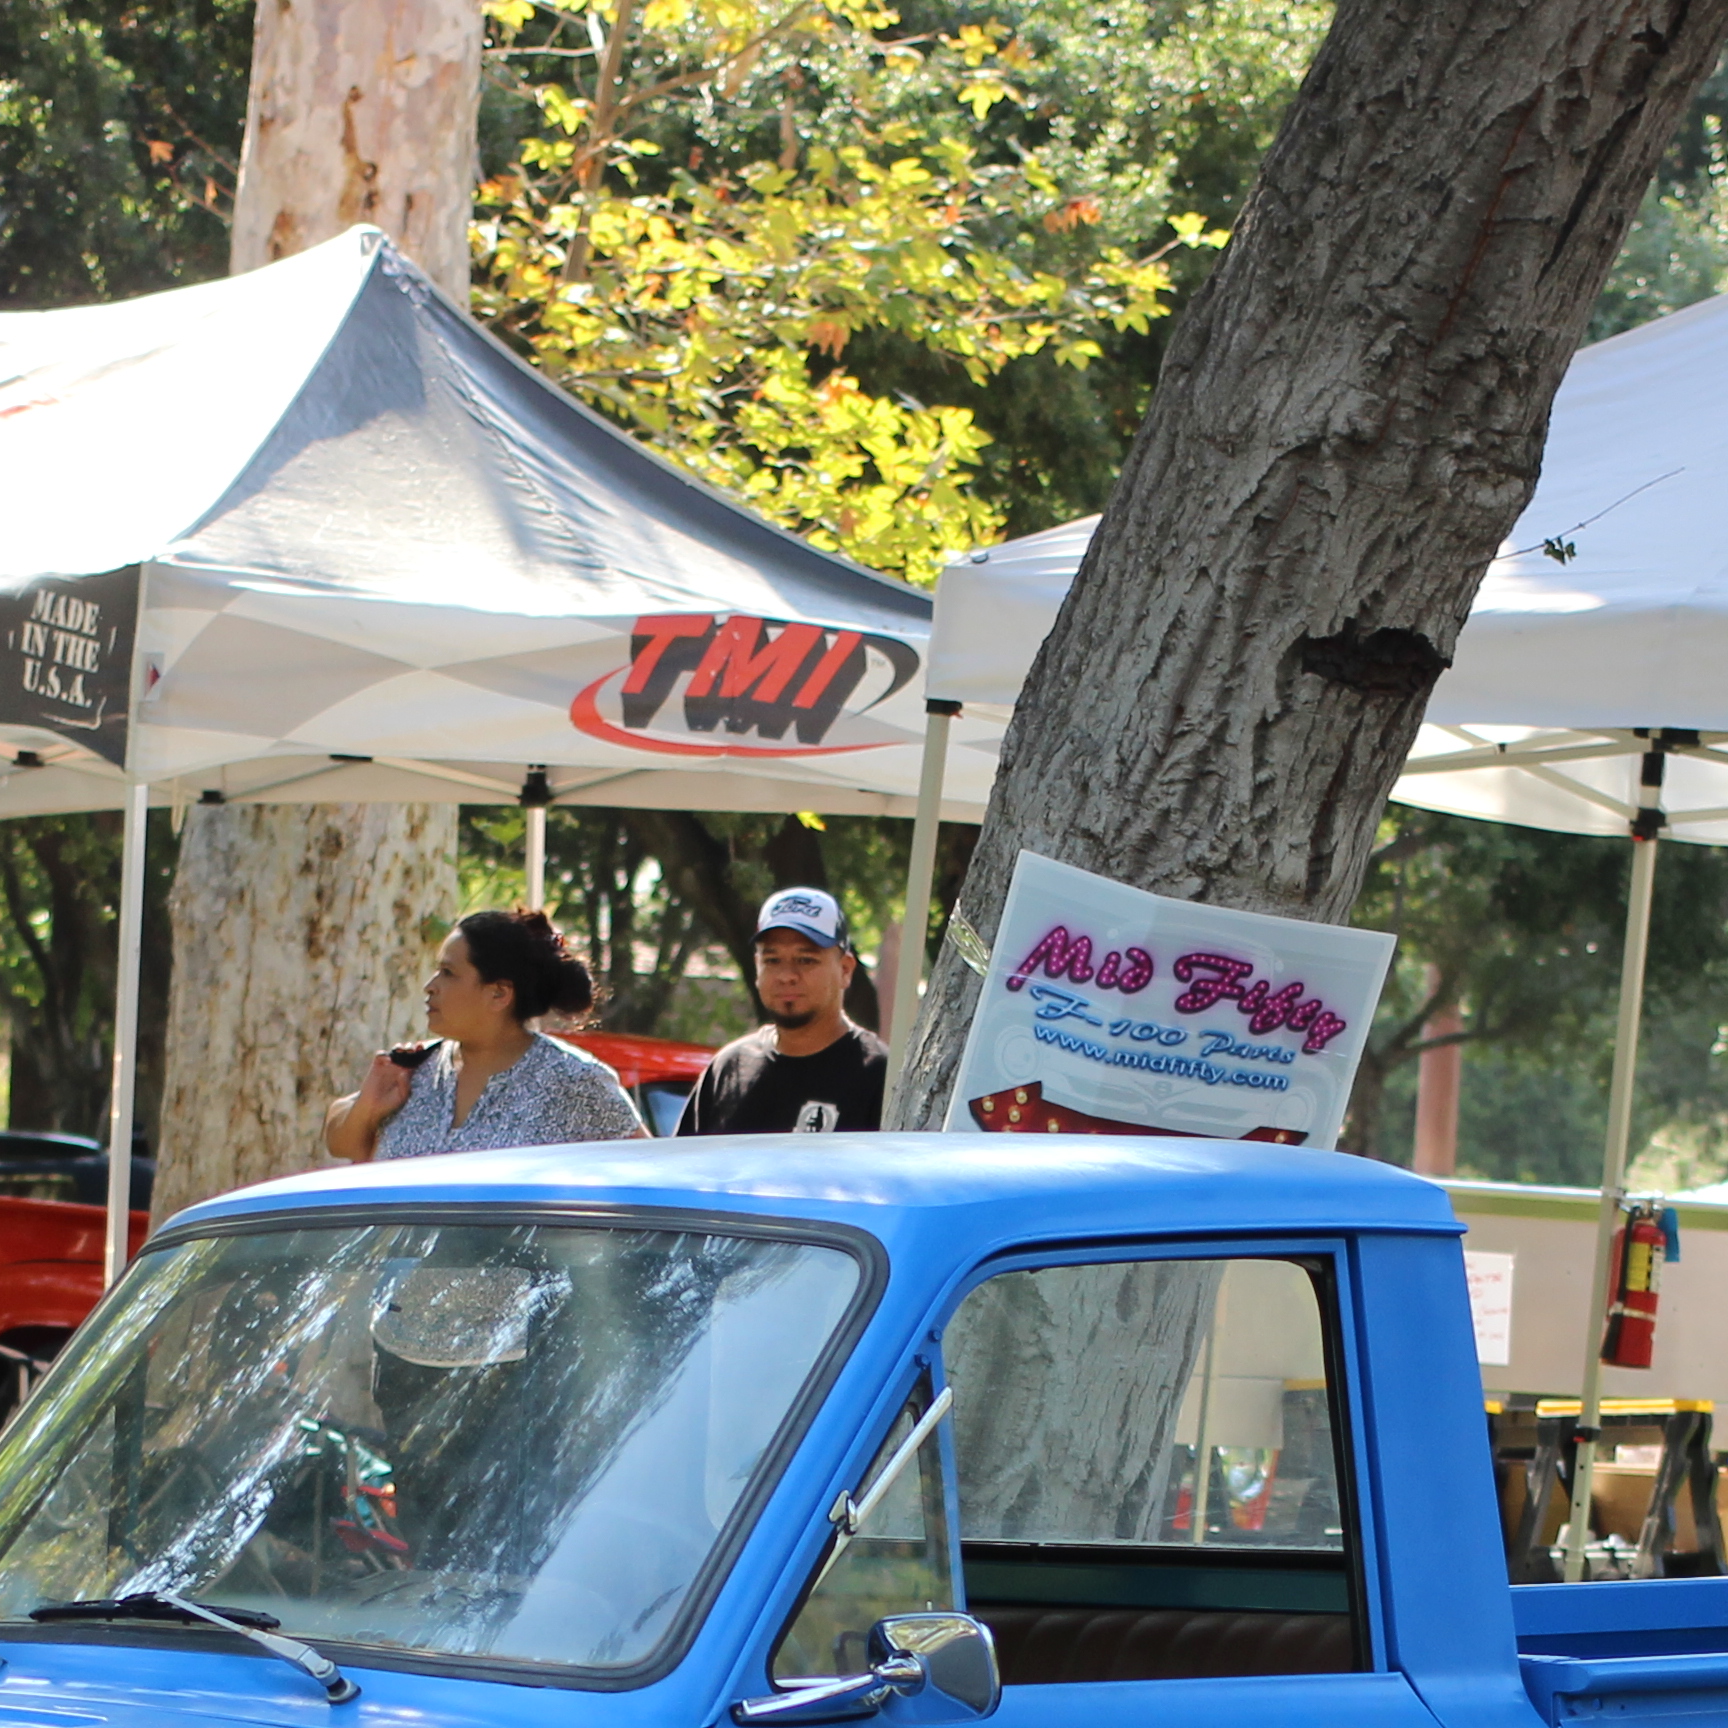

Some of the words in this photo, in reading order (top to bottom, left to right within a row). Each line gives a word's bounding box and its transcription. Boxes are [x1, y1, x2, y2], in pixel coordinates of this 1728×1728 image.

[30, 588, 101, 637] MADE
[21, 621, 50, 658] IN
[52, 630, 101, 674] THE
[22, 657, 93, 709] U.S.A.
[620, 614, 868, 744] TMI
[770, 895, 823, 918] Ford
[1029, 983, 1188, 1048] F-100
[1198, 1029, 1298, 1066] Parts
[1174, 952, 1347, 1055] Fifty
[1032, 1023, 1291, 1093] www.midfifty.com
